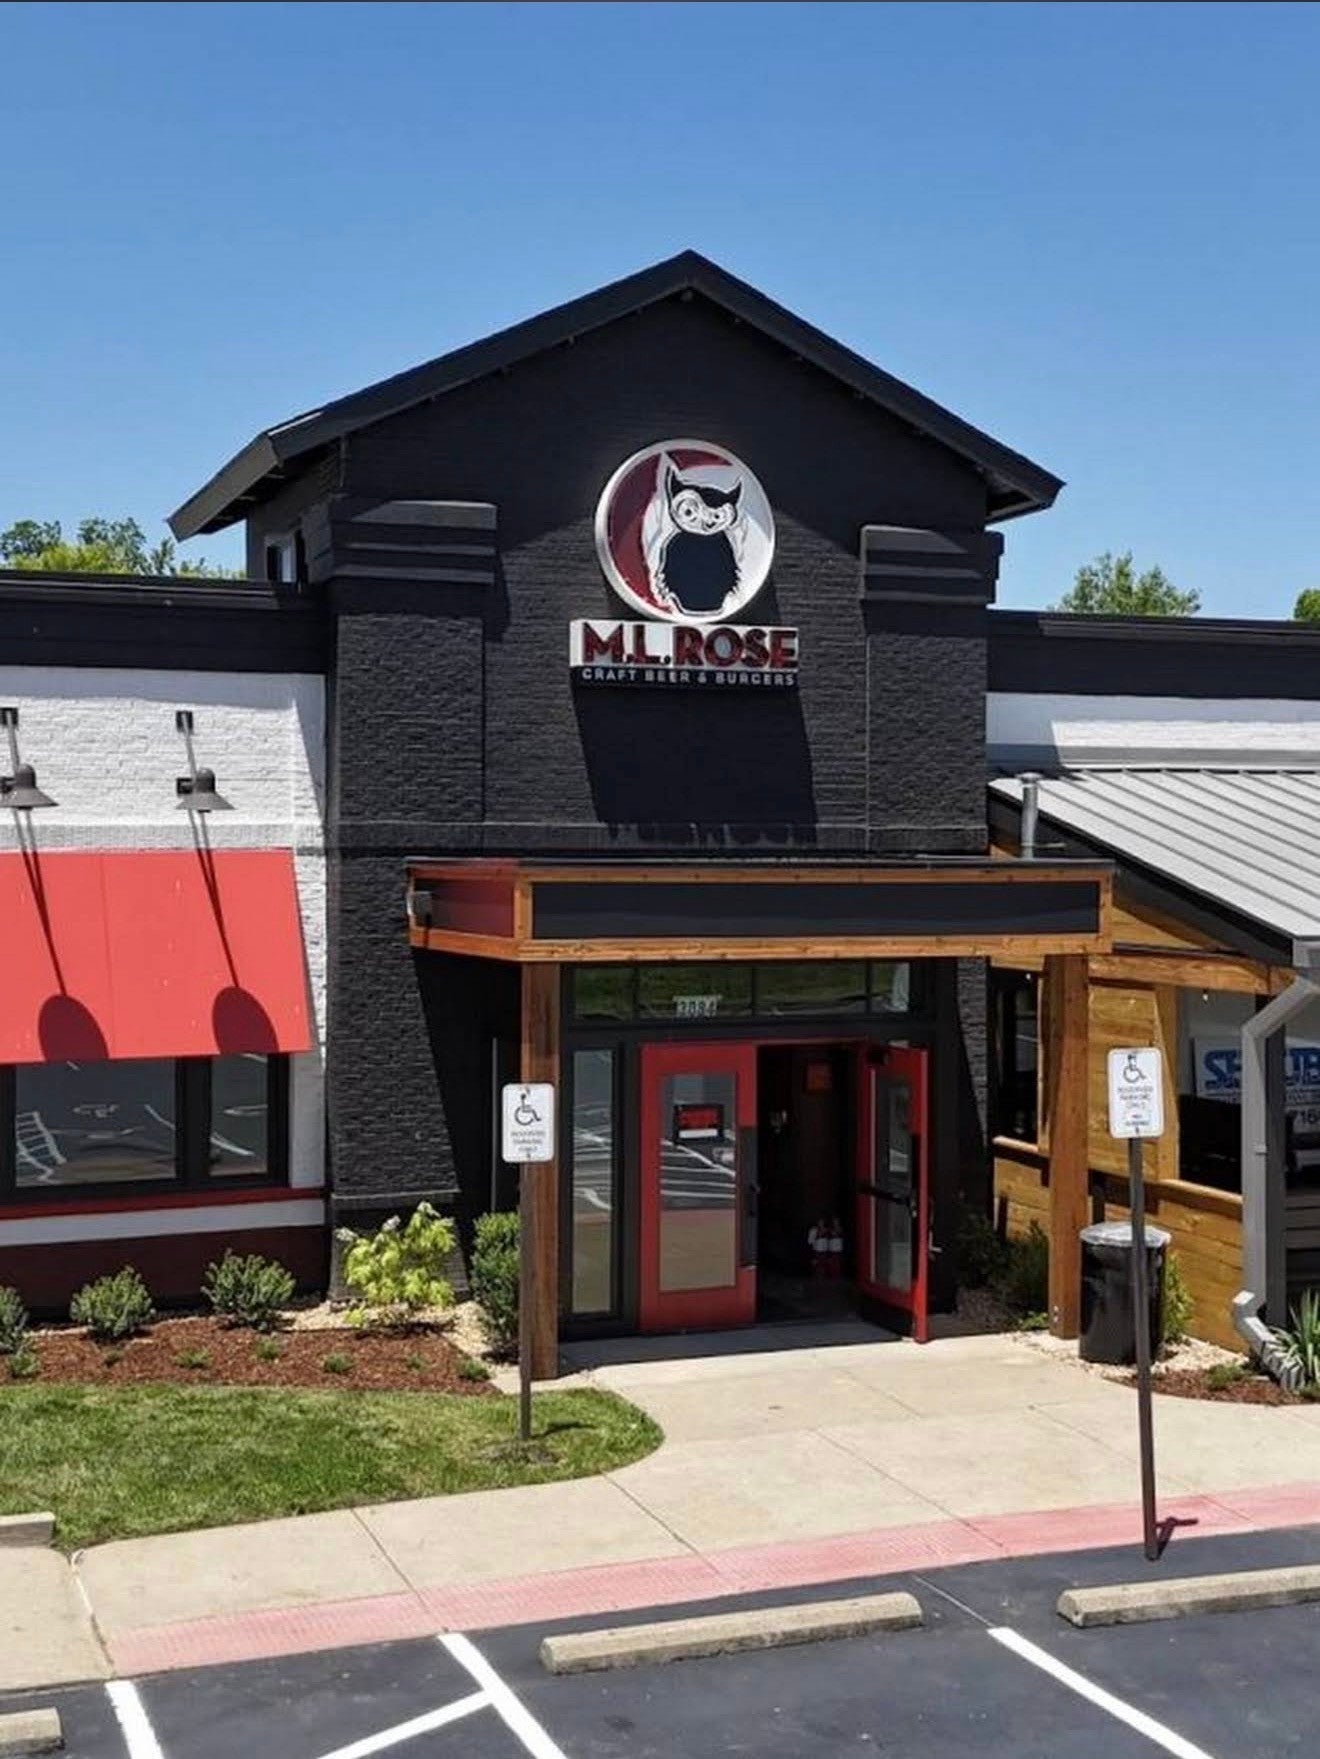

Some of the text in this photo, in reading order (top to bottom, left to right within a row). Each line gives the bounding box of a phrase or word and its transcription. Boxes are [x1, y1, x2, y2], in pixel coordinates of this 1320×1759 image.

[582, 668, 795, 686] CRAFT BEER & BURGERS
